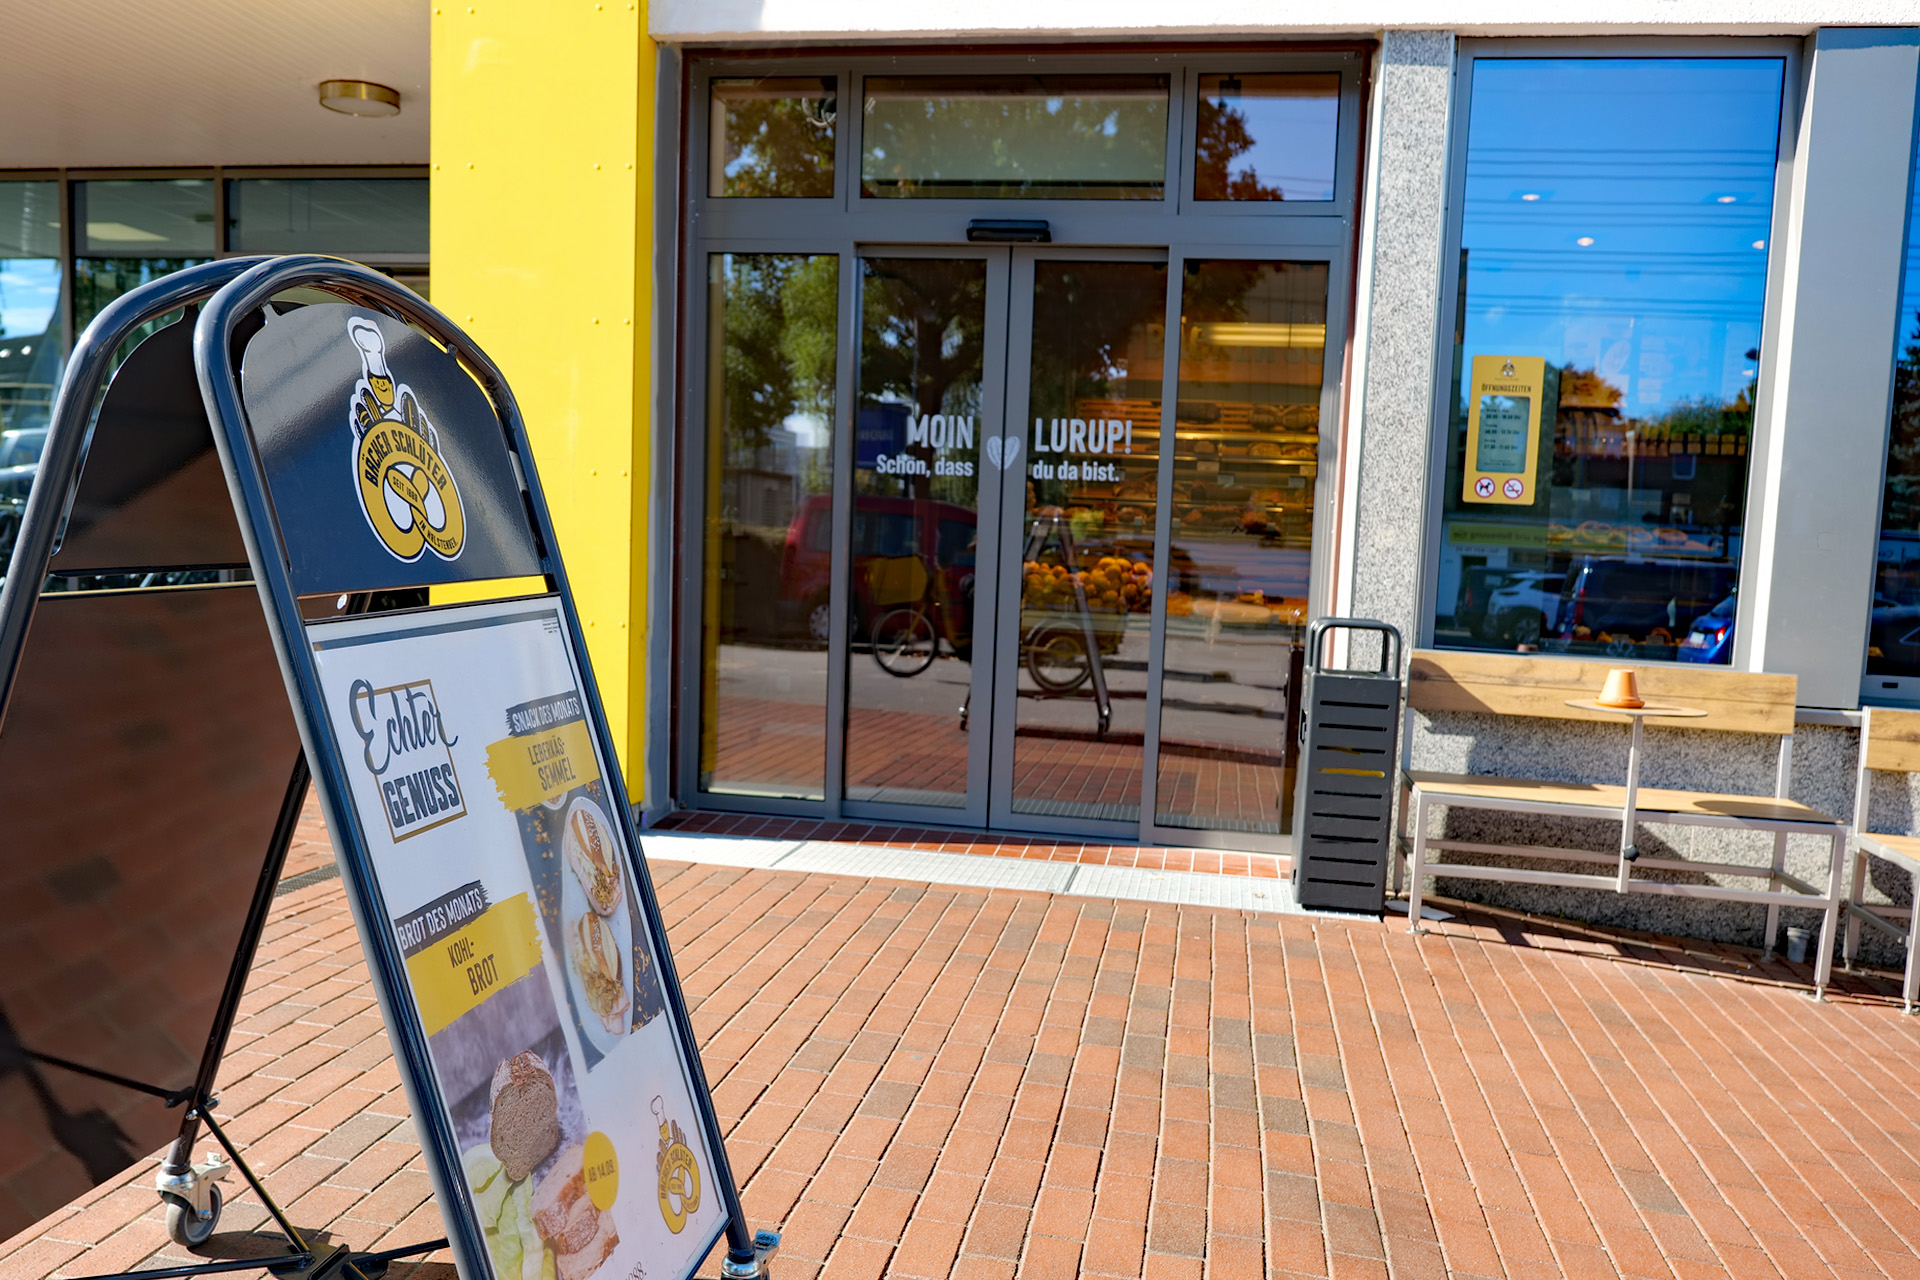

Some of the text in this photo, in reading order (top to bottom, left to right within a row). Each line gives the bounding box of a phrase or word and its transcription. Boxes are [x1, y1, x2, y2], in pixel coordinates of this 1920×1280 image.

[1481, 382, 1532, 393] ÖFFNUNGSZEITEN
[906, 414, 1132, 454] MOIN LURUP!
[362, 430, 447, 491] BÄCKER SCHLÜTER
[876, 453, 1120, 482] Schön, dass du da bist.
[392, 476, 405, 492] SEIT
[349, 679, 459, 775] Echter
[512, 697, 581, 733] SNACK DES MONATS
[527, 735, 566, 766] LEBERKÄS-
[538, 757, 577, 791] SEMMEL
[382, 762, 460, 829] GENUSS
[398, 888, 483, 951] BROT DES MONATS
[447, 937, 475, 968] KOHL-
[466, 954, 499, 996] BROT
